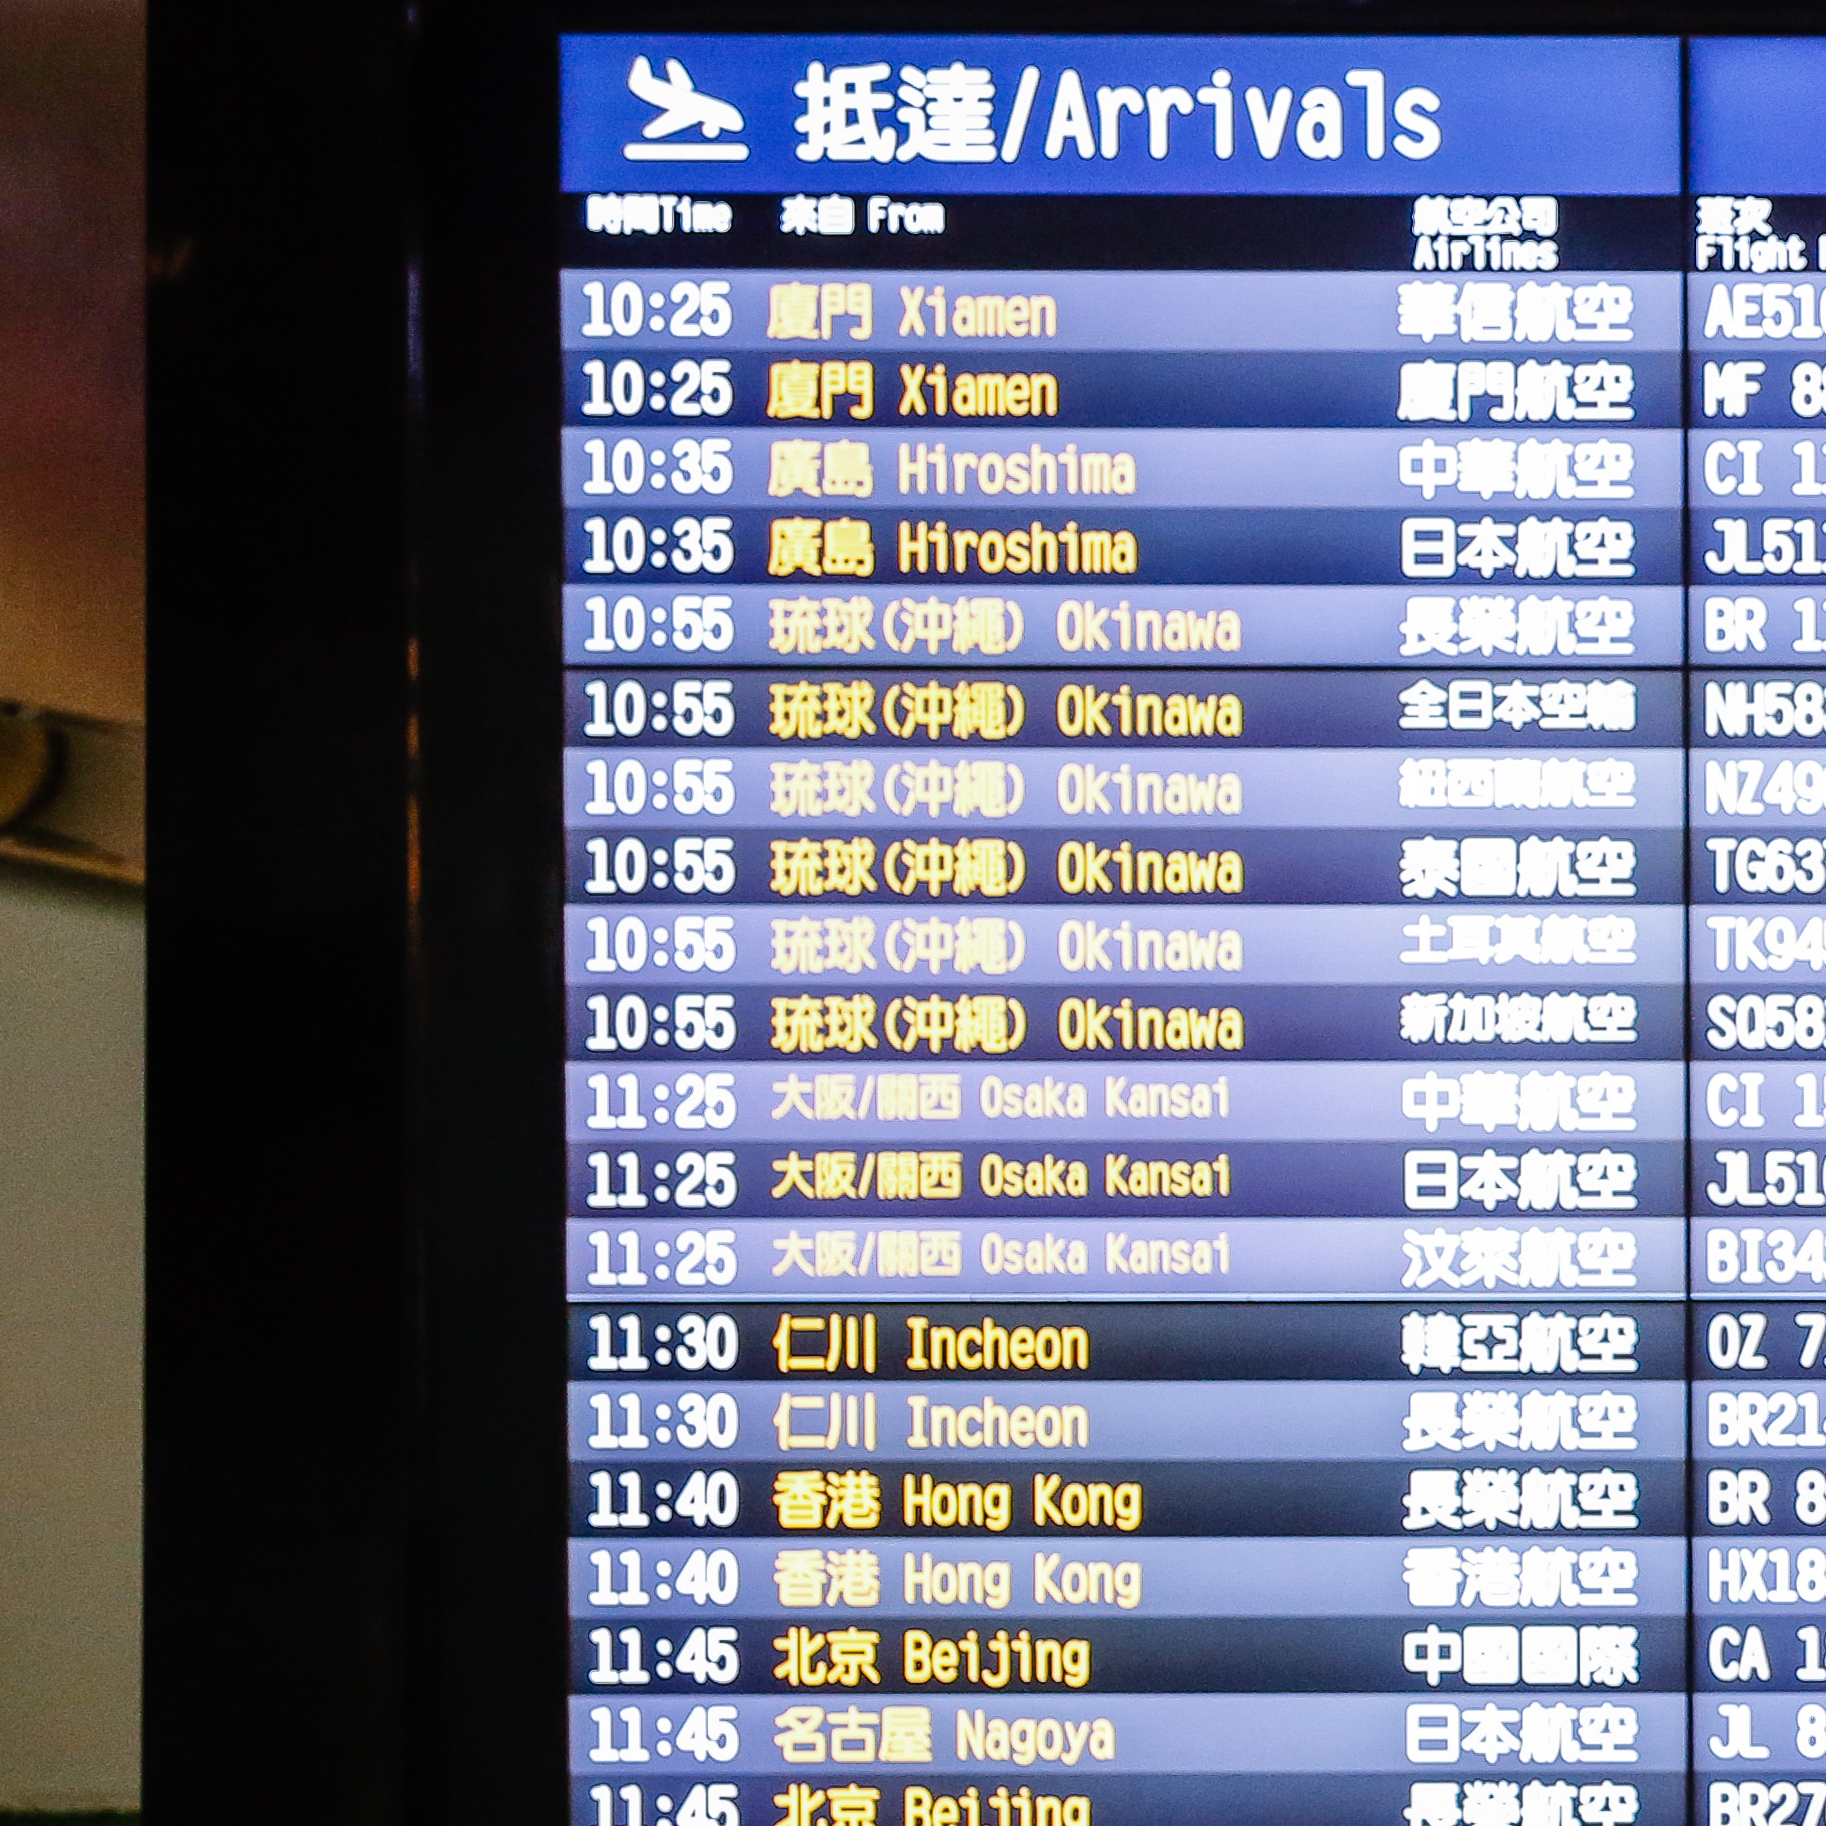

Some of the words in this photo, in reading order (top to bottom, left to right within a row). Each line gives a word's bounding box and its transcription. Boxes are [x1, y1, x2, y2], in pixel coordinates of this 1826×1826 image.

[794, 62, 1441, 163] 抵達/Arrivals
[781, 195, 854, 235] 來自
[868, 196, 945, 234] From
[1413, 196, 1557, 236] 航空公司
[1413, 236, 1558, 271] Airlines
[1697, 236, 1806, 274] Flight
[583, 359, 732, 416] 10:25
[766, 358, 874, 421] 廈門
[898, 363, 1058, 417] Xiamen
[1397, 359, 1634, 421] 廈門航空
[1703, 361, 1765, 416] MF
[584, 517, 733, 573] 10:35
[767, 516, 875, 578] 廣島
[898, 520, 1138, 575] Hiroshima
[1401, 516, 1635, 578] 日本航空
[586, 837, 735, 893] 10:55
[1056, 839, 1243, 894] Okinawa
[1399, 835, 1636, 898] 泰國航空
[587, 994, 736, 1050] 10:55
[1057, 997, 1244, 1051] Okinawa
[1400, 991, 1637, 1043] 新加坡航空
[588, 1151, 737, 1207] 11:25
[979, 1152, 1088, 1198] Osaka
[1104, 1152, 1231, 1198] Kansai
[1404, 1148, 1637, 1210] 日本航空
[589, 1471, 738, 1527] 11:40
[771, 1469, 882, 1530] 香港
[902, 1472, 1012, 1532] Hong
[1033, 1472, 1143, 1532] Kong
[1402, 1467, 1637, 1530] 長榮航空
[1708, 1469, 1770, 1525] BR
[589, 1627, 739, 1684] 11:45
[772, 1625, 881, 1687] 北京
[903, 1628, 1091, 1689] Beijing
[1403, 1624, 1638, 1686] 中國國際
[1708, 1626, 1770, 1680] CA
